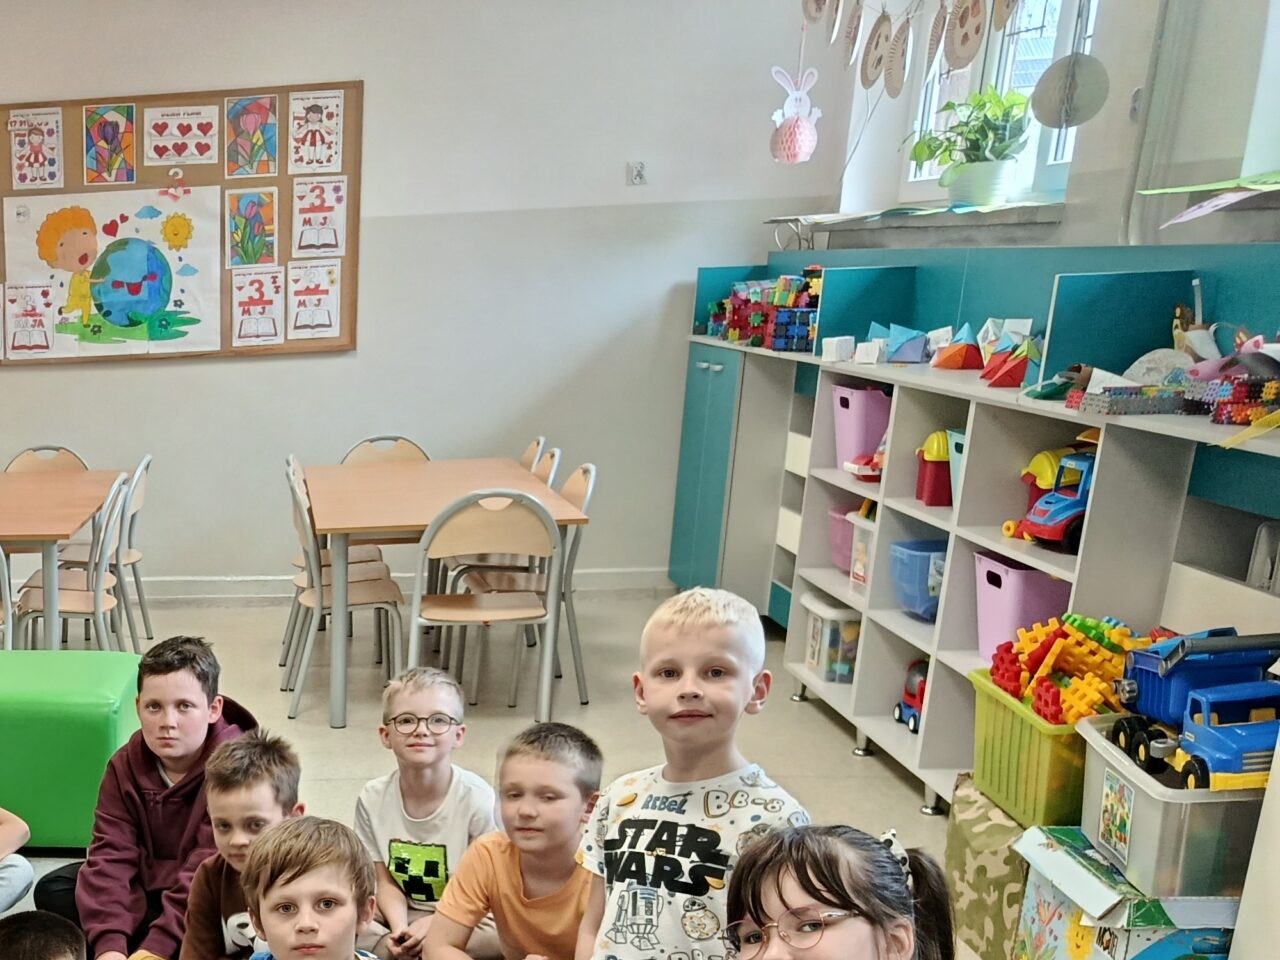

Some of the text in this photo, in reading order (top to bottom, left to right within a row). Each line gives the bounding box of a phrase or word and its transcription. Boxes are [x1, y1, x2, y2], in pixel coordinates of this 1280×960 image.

[248, 279, 265, 300] 3
[704, 790, 784, 818] BB-8
[604, 819, 730, 867] STAR
[604, 851, 726, 897] WARS
